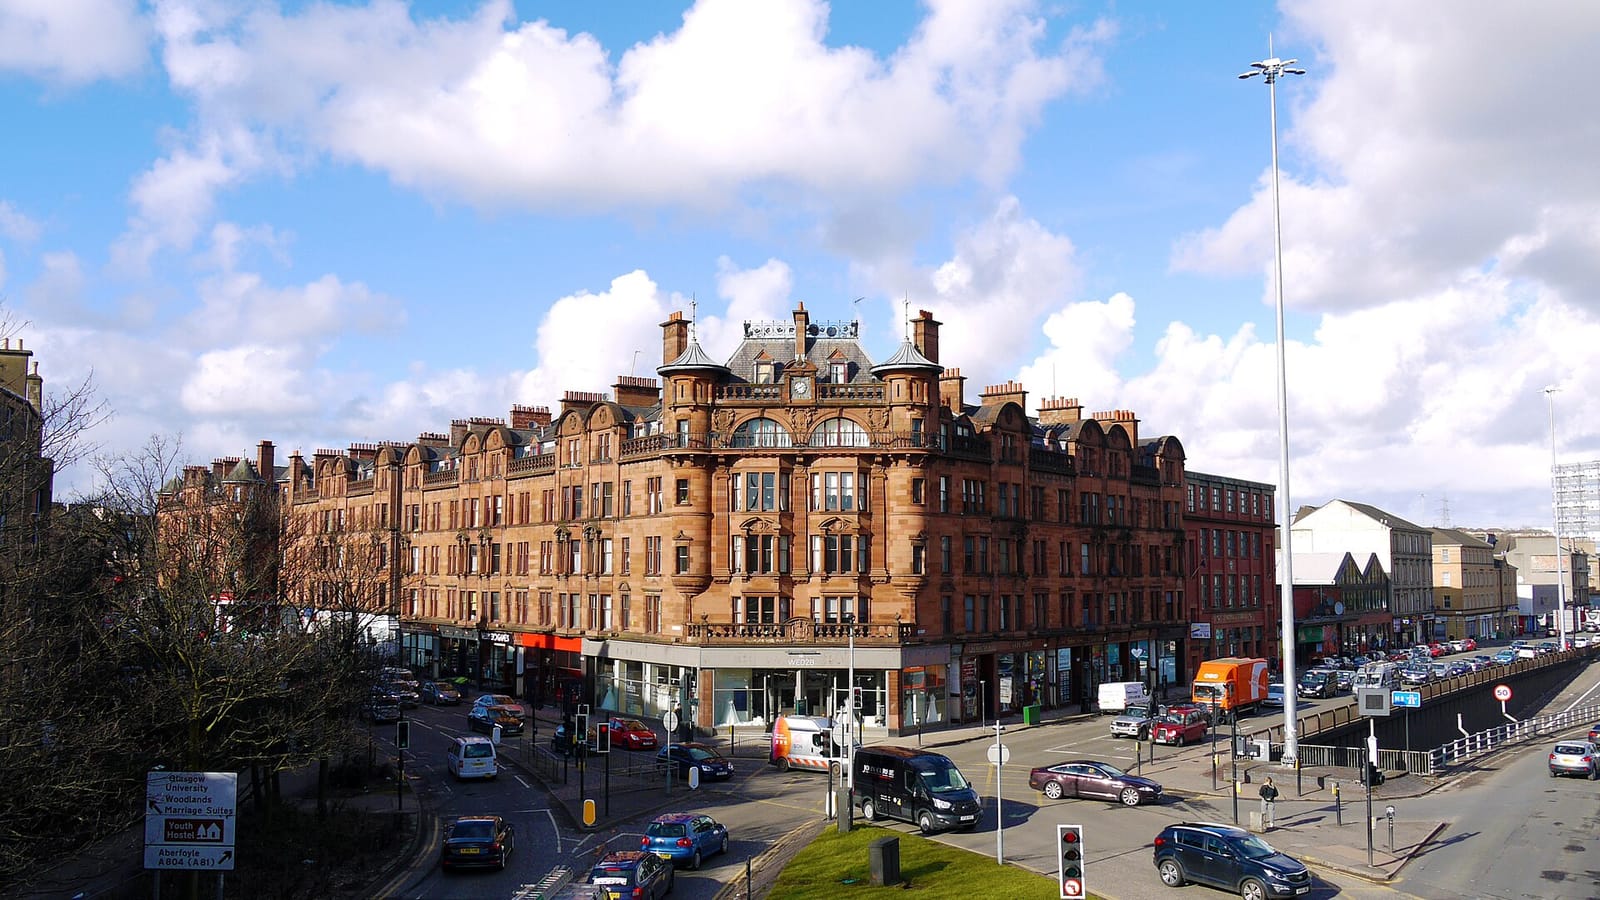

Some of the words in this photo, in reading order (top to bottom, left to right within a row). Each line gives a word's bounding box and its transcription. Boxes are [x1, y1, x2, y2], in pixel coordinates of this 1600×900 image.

[169, 774, 206, 783] Glasgow
[165, 784, 208, 793] University
[165, 795, 212, 803] Woodlands
[164, 806, 203, 815] Marriage
[206, 806, 233, 815] Suites
[168, 821, 194, 830] Youth
[167, 830, 195, 839] Hostel
[158, 848, 200, 857] Aberfoyle
[158, 858, 184, 866] A804
[187, 858, 216, 866] (A81)
